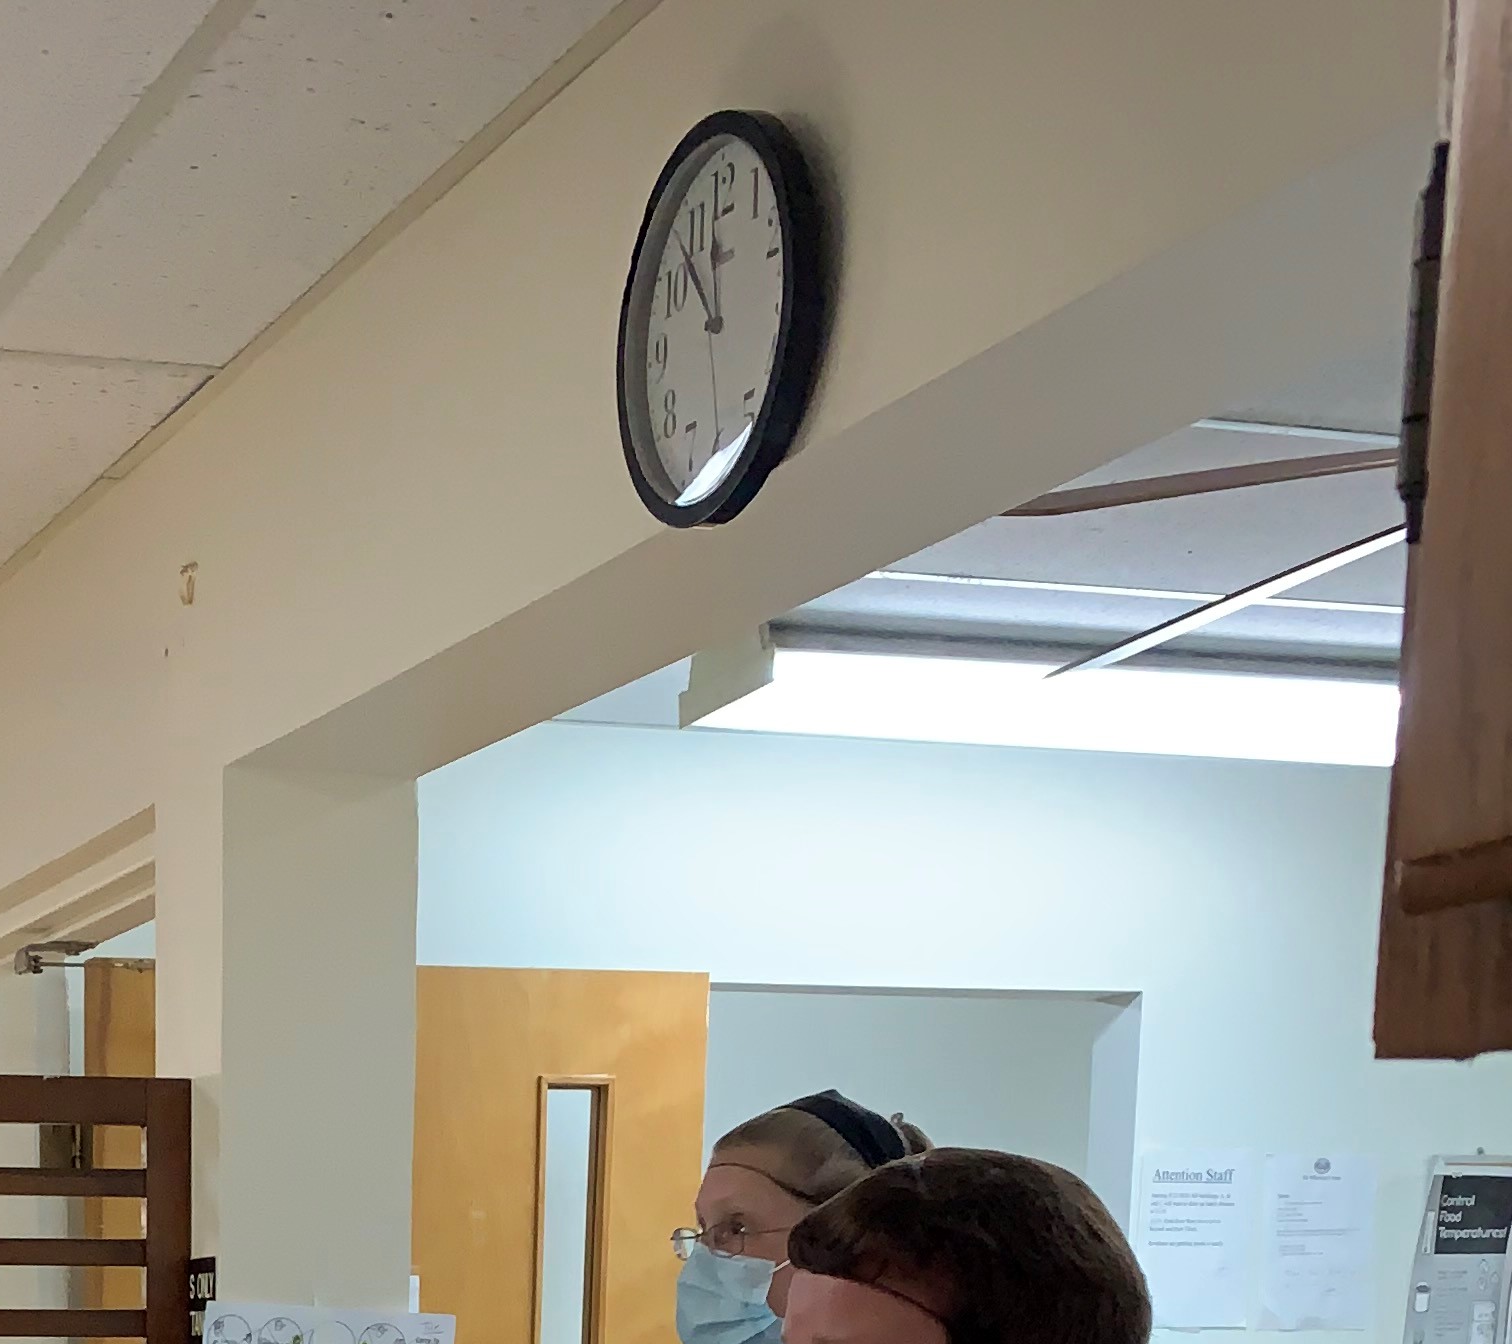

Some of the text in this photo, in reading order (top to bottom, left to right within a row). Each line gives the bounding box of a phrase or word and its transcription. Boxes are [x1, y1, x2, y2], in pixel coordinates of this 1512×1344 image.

[711, 161, 736, 221] 12
[750, 166, 759, 220] 1
[688, 201, 705, 260] 11
[664, 262, 689, 320] 10
[655, 332, 668, 384] 9
[664, 388, 677, 438] 8
[685, 420, 697, 472] 7
[1152, 1168, 1236, 1182] Attention Staff
[1441, 1194, 1476, 1207] Control
[1439, 1210, 1462, 1223] Food
